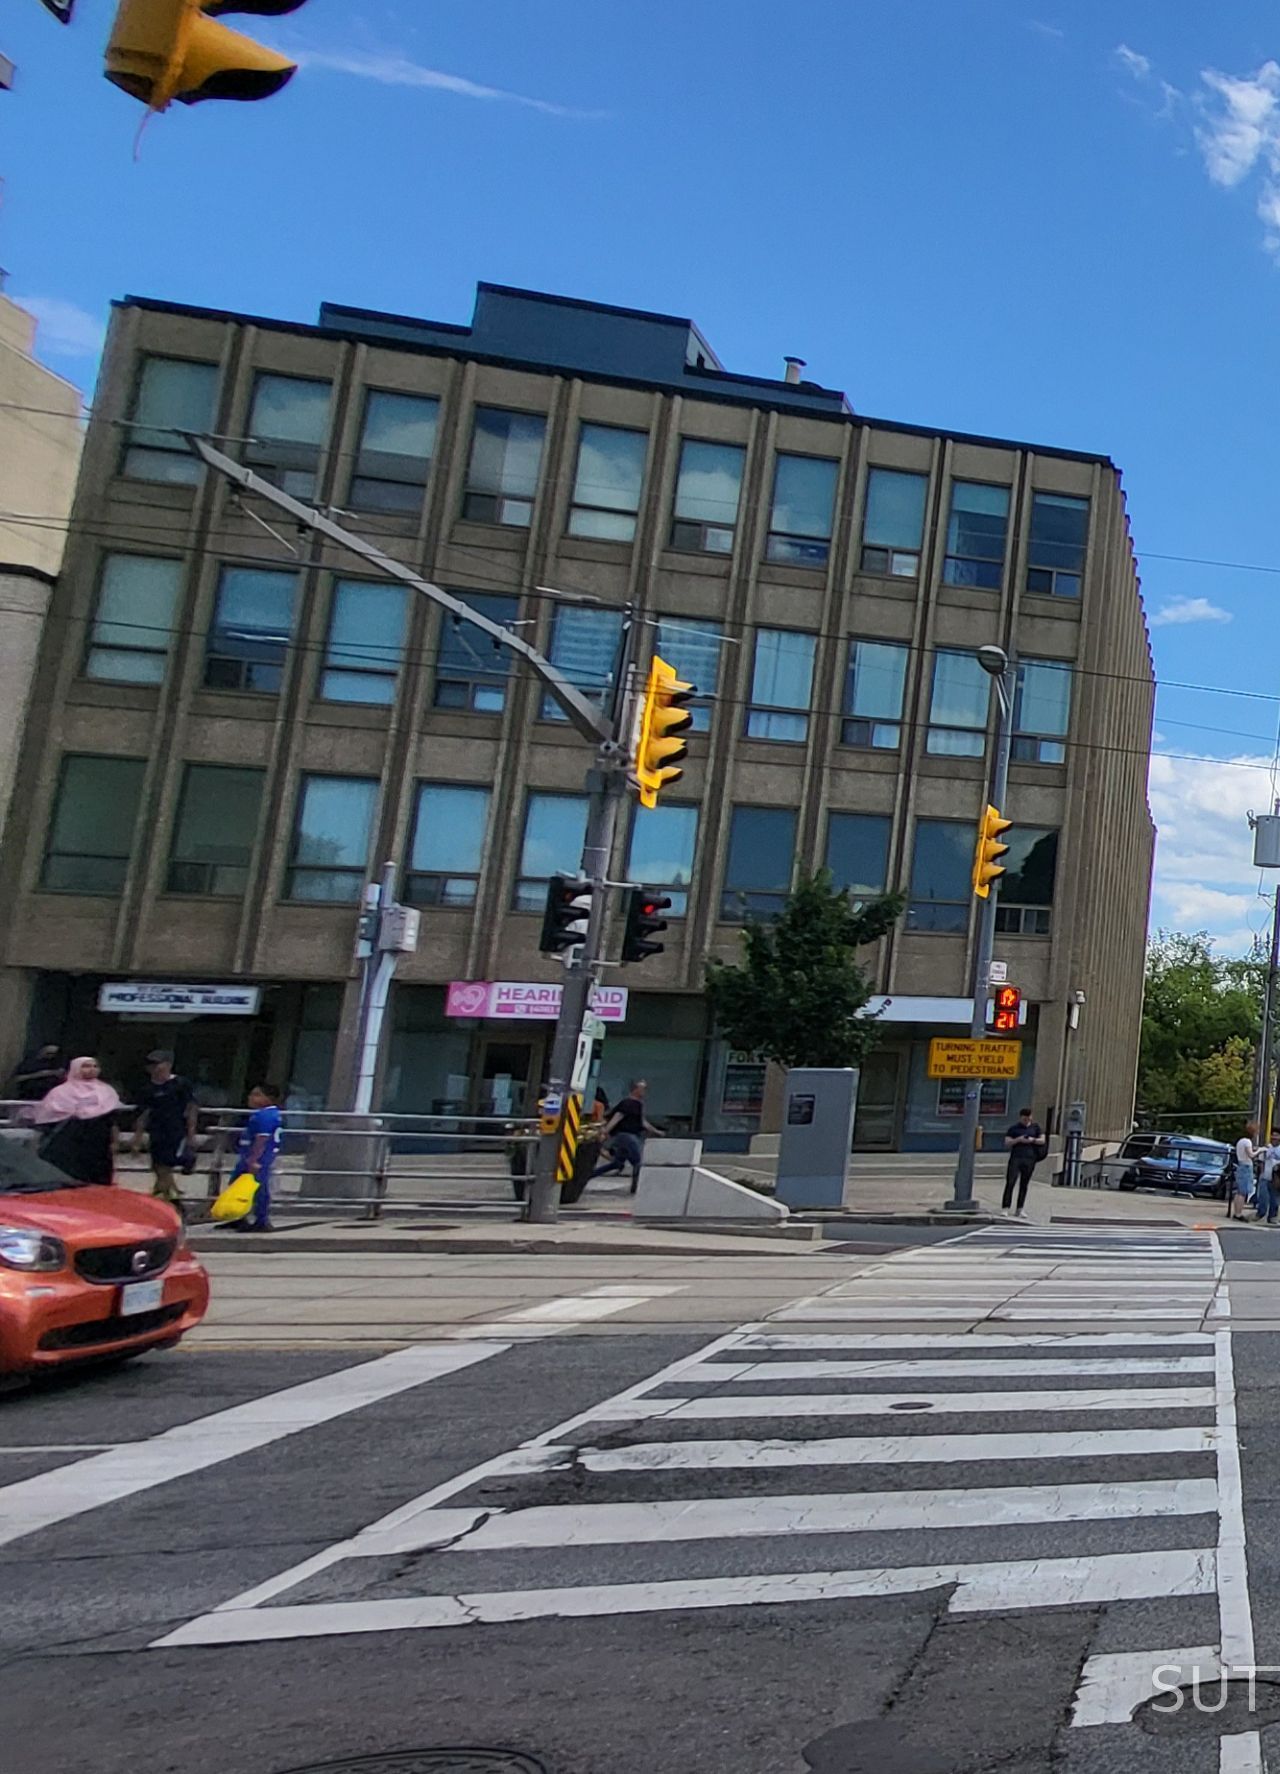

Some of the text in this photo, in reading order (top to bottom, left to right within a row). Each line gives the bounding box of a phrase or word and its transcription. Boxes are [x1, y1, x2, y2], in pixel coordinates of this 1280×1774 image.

[594, 991, 624, 1004] AID
[996, 1013, 1014, 1029] 21
[936, 1042, 1017, 1053] TURNING TRAFFIC
[946, 1054, 1004, 1064] MUST YIELD
[933, 1063, 1015, 1074] TO PEDESTRIANS
